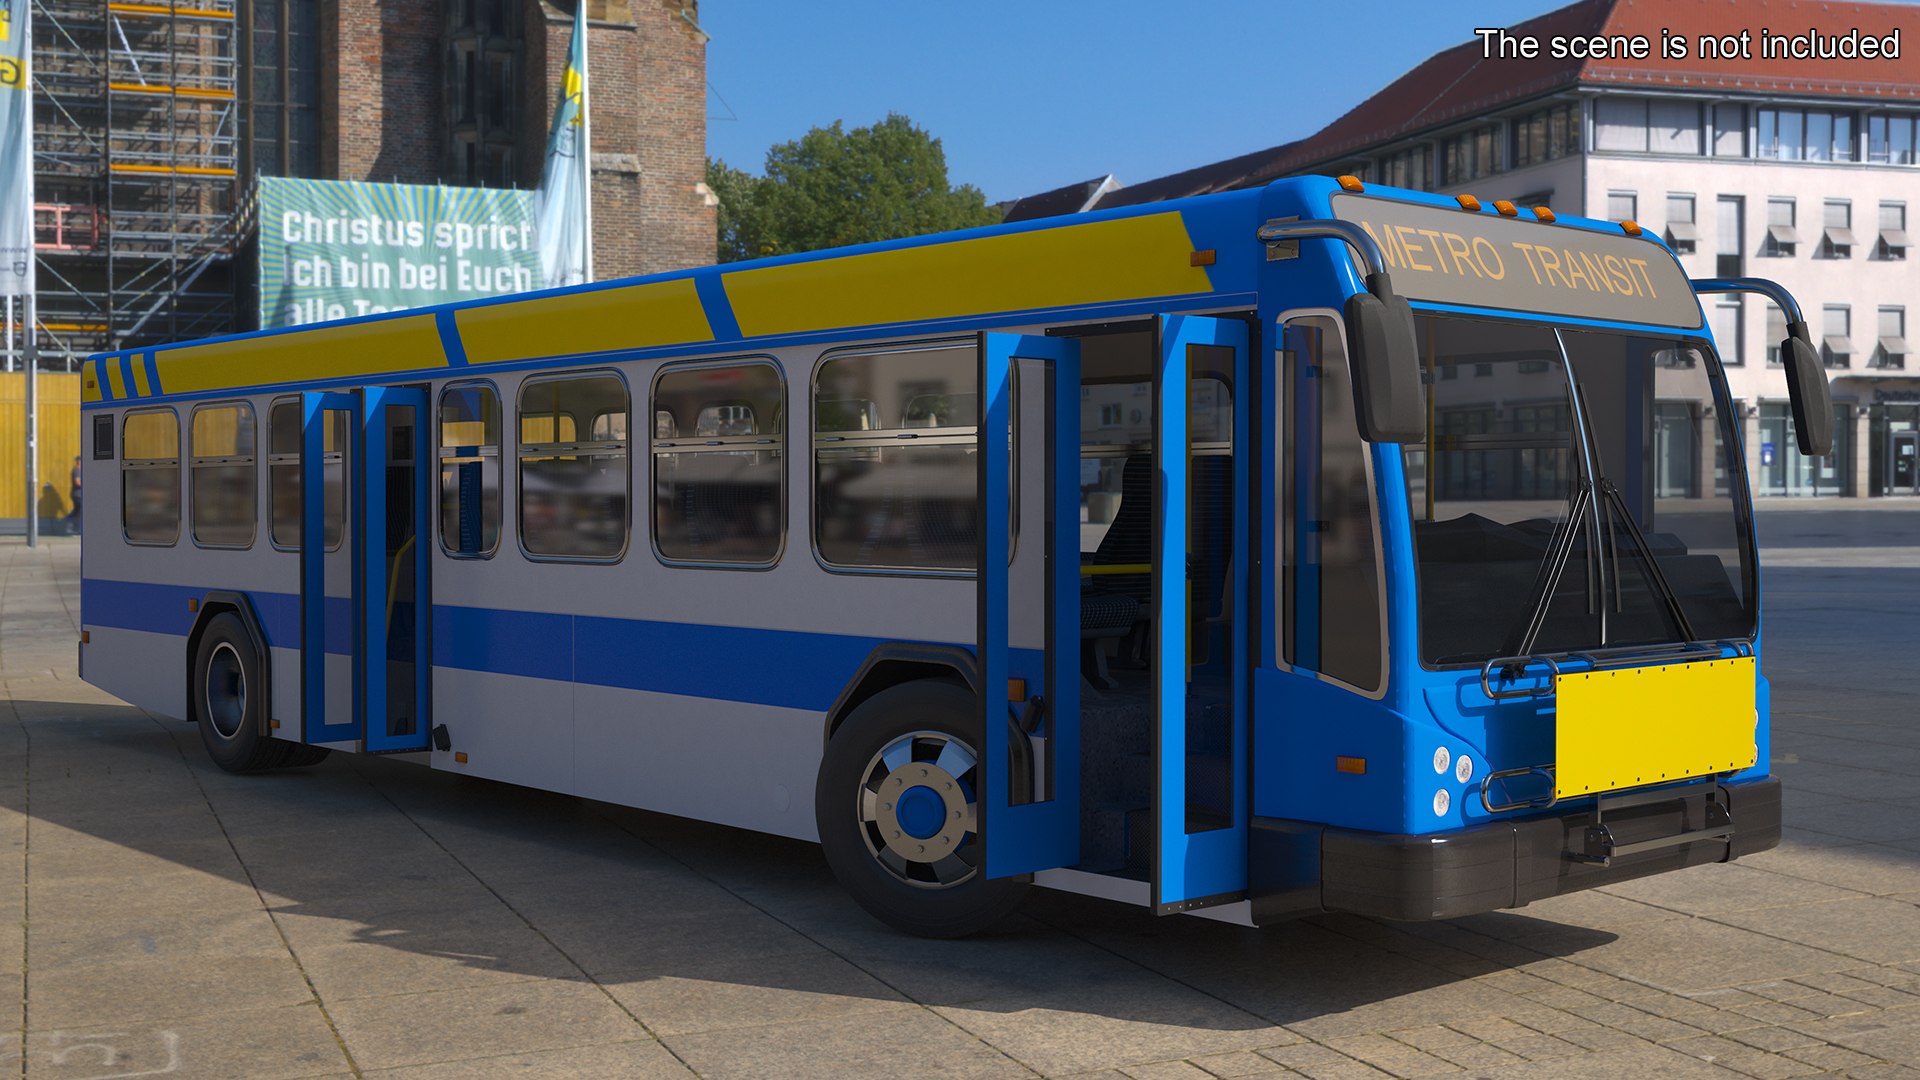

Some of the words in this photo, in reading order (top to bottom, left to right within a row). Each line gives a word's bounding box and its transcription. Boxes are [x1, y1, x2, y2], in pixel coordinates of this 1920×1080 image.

[283, 208, 424, 247] Christus
[340, 252, 391, 289] bin
[400, 255, 448, 291] bei
[457, 259, 532, 292] Euch
[1361, 221, 1504, 280] METRO
[1512, 241, 1657, 299] TRANSIT
